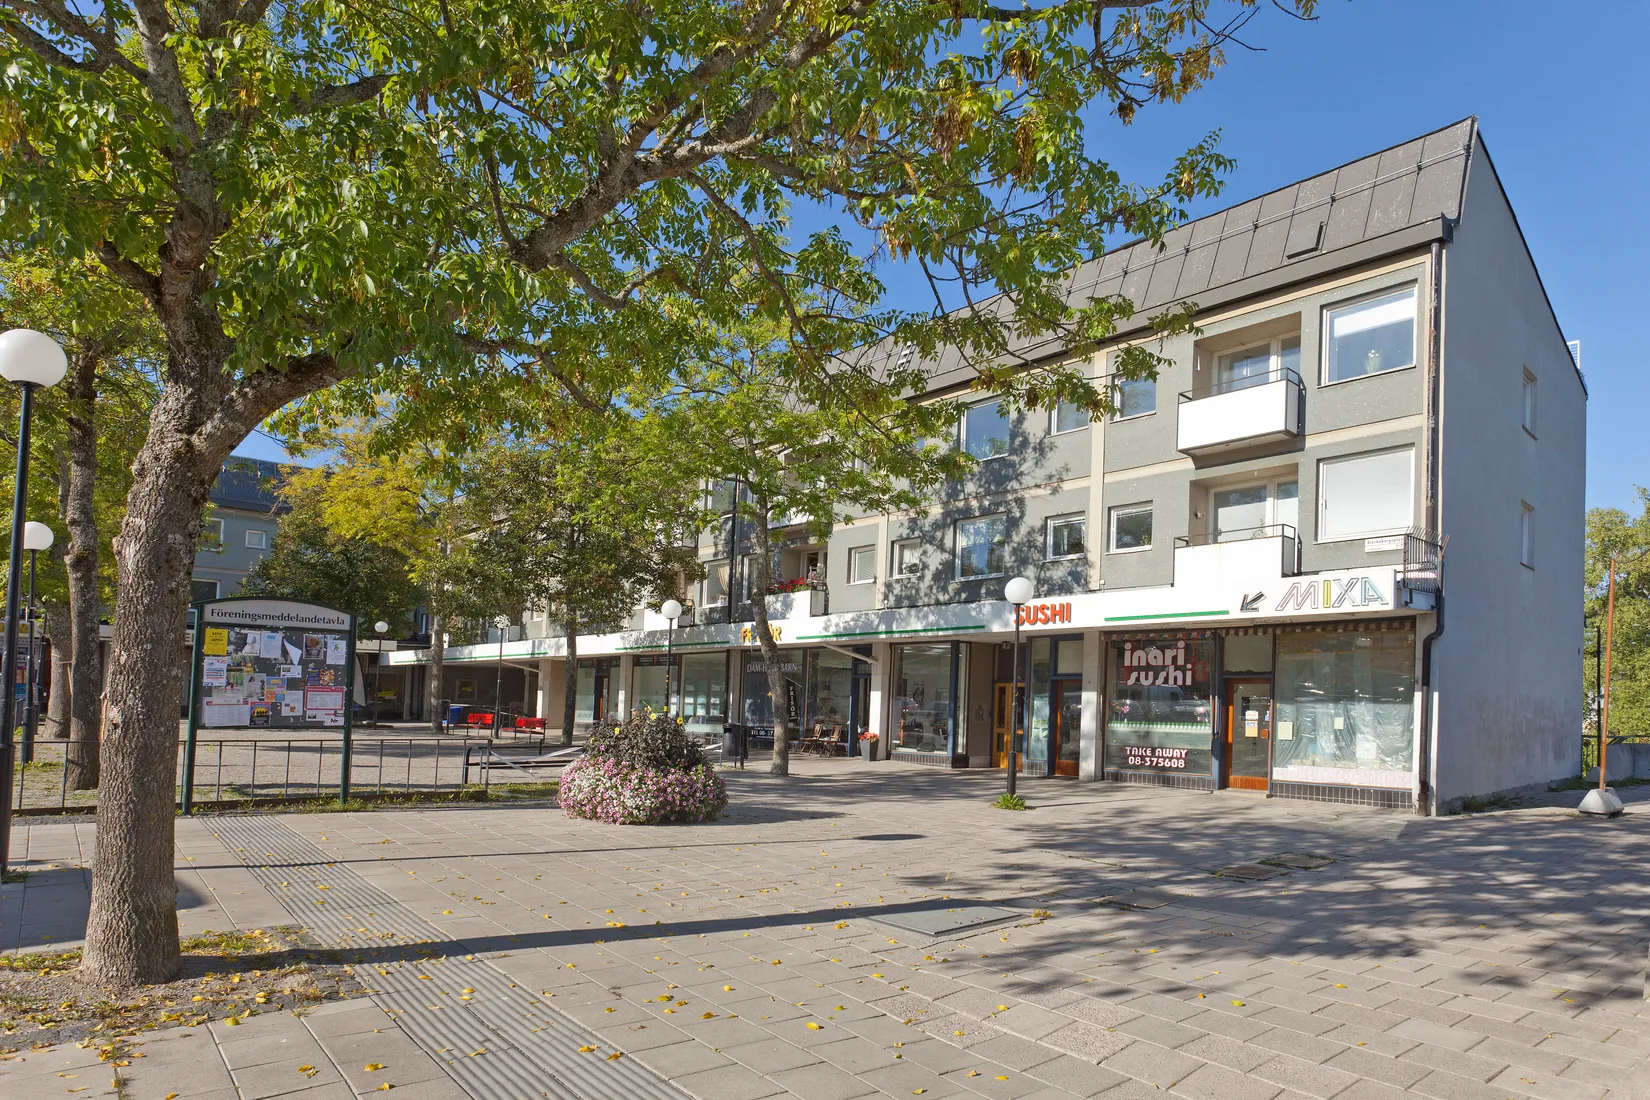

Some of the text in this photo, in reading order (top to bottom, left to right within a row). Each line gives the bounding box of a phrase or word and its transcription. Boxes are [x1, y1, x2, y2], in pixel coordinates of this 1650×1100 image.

[1275, 577, 1389, 612] MIXA
[210, 608, 345, 626] Föreningsmeddelandetavla
[1013, 602, 1072, 626] SUSHI
[1124, 640, 1185, 667] inari
[1126, 664, 1192, 686] sushi
[1125, 747, 1189, 759] TAKE AWAY
[1128, 756, 1186, 769] 08-375608
